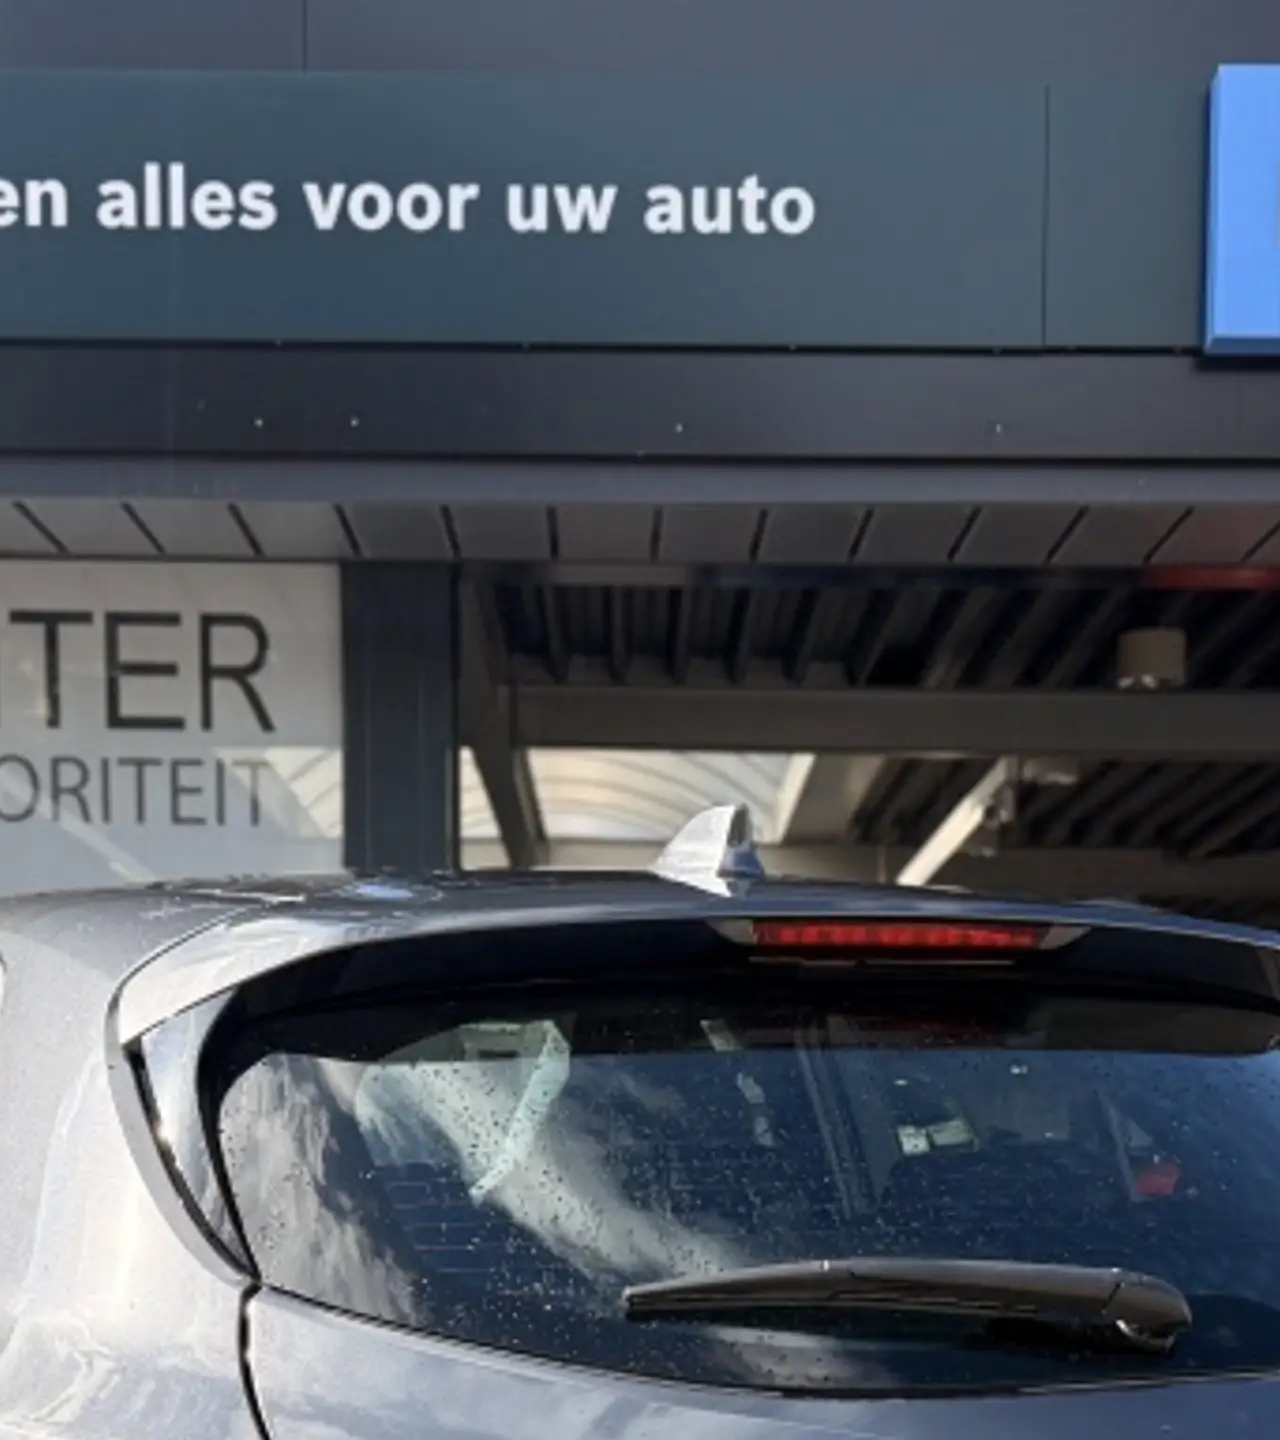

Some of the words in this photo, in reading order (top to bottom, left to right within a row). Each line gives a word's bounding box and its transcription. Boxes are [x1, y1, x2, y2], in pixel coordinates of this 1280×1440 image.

[96, 162, 277, 230] alles
[302, 181, 480, 232] voor
[507, 184, 618, 233] uw
[644, 174, 815, 235] auto
